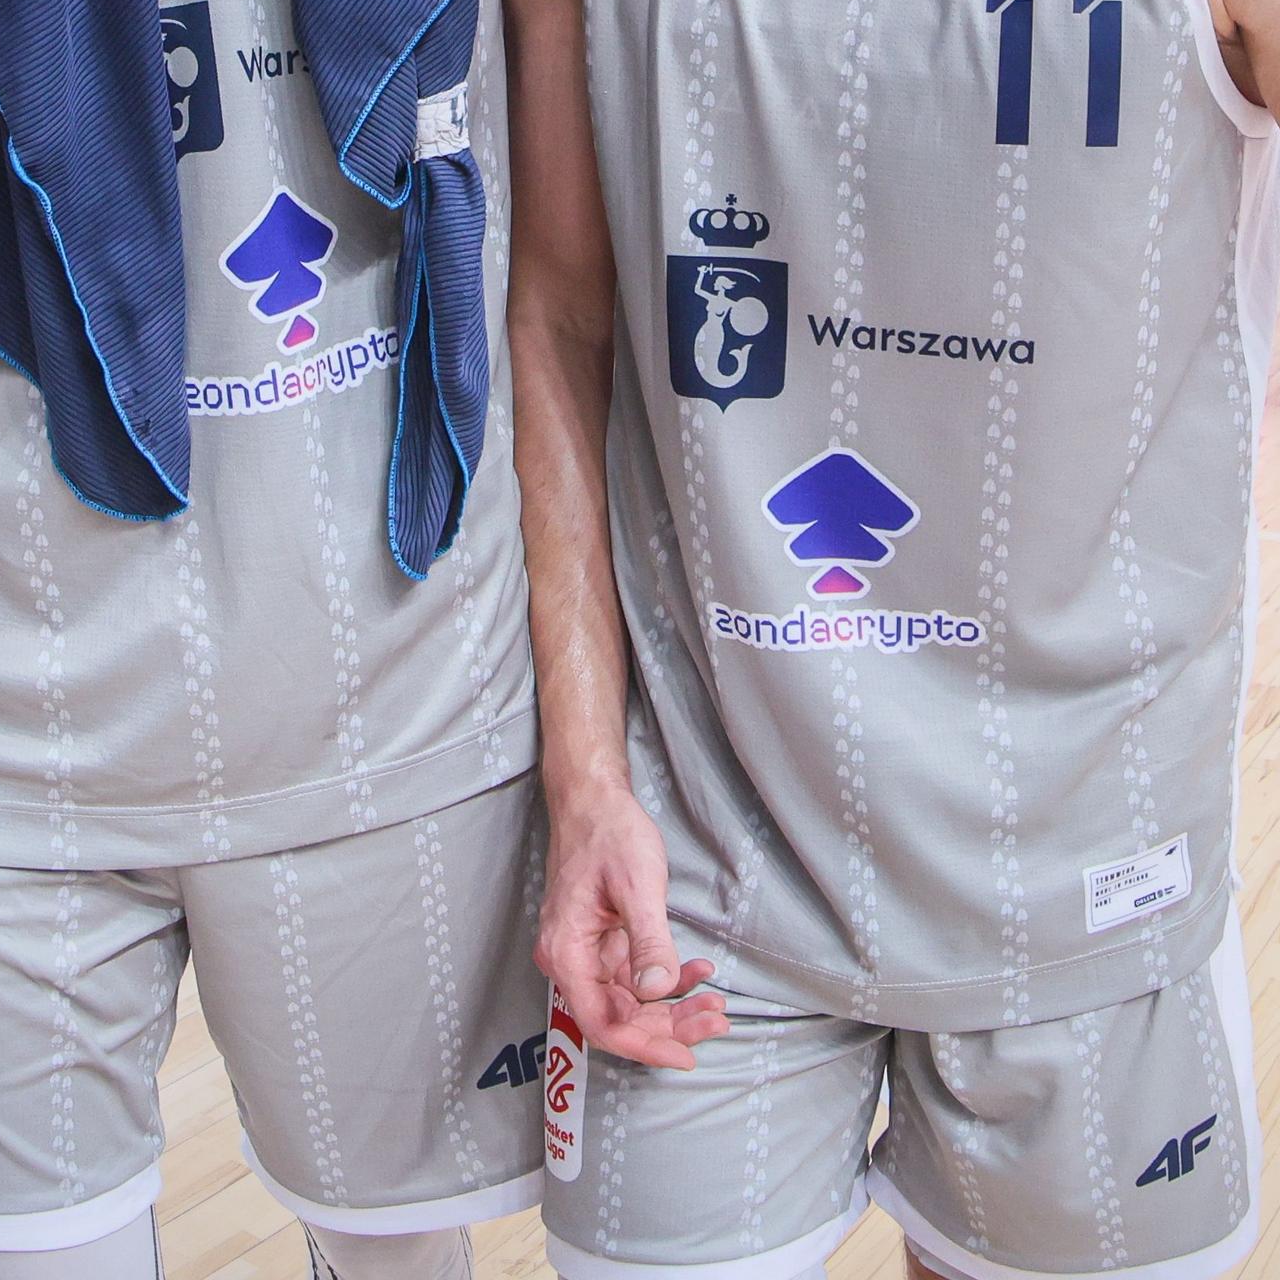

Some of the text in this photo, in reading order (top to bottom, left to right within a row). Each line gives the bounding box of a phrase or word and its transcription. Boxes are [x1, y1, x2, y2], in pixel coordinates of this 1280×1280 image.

[808, 314, 1036, 365] Warszawa
[715, 607, 979, 647] zondacrypto
[546, 1133, 565, 1161] Liga
[1135, 1114, 1218, 1186] 4F
